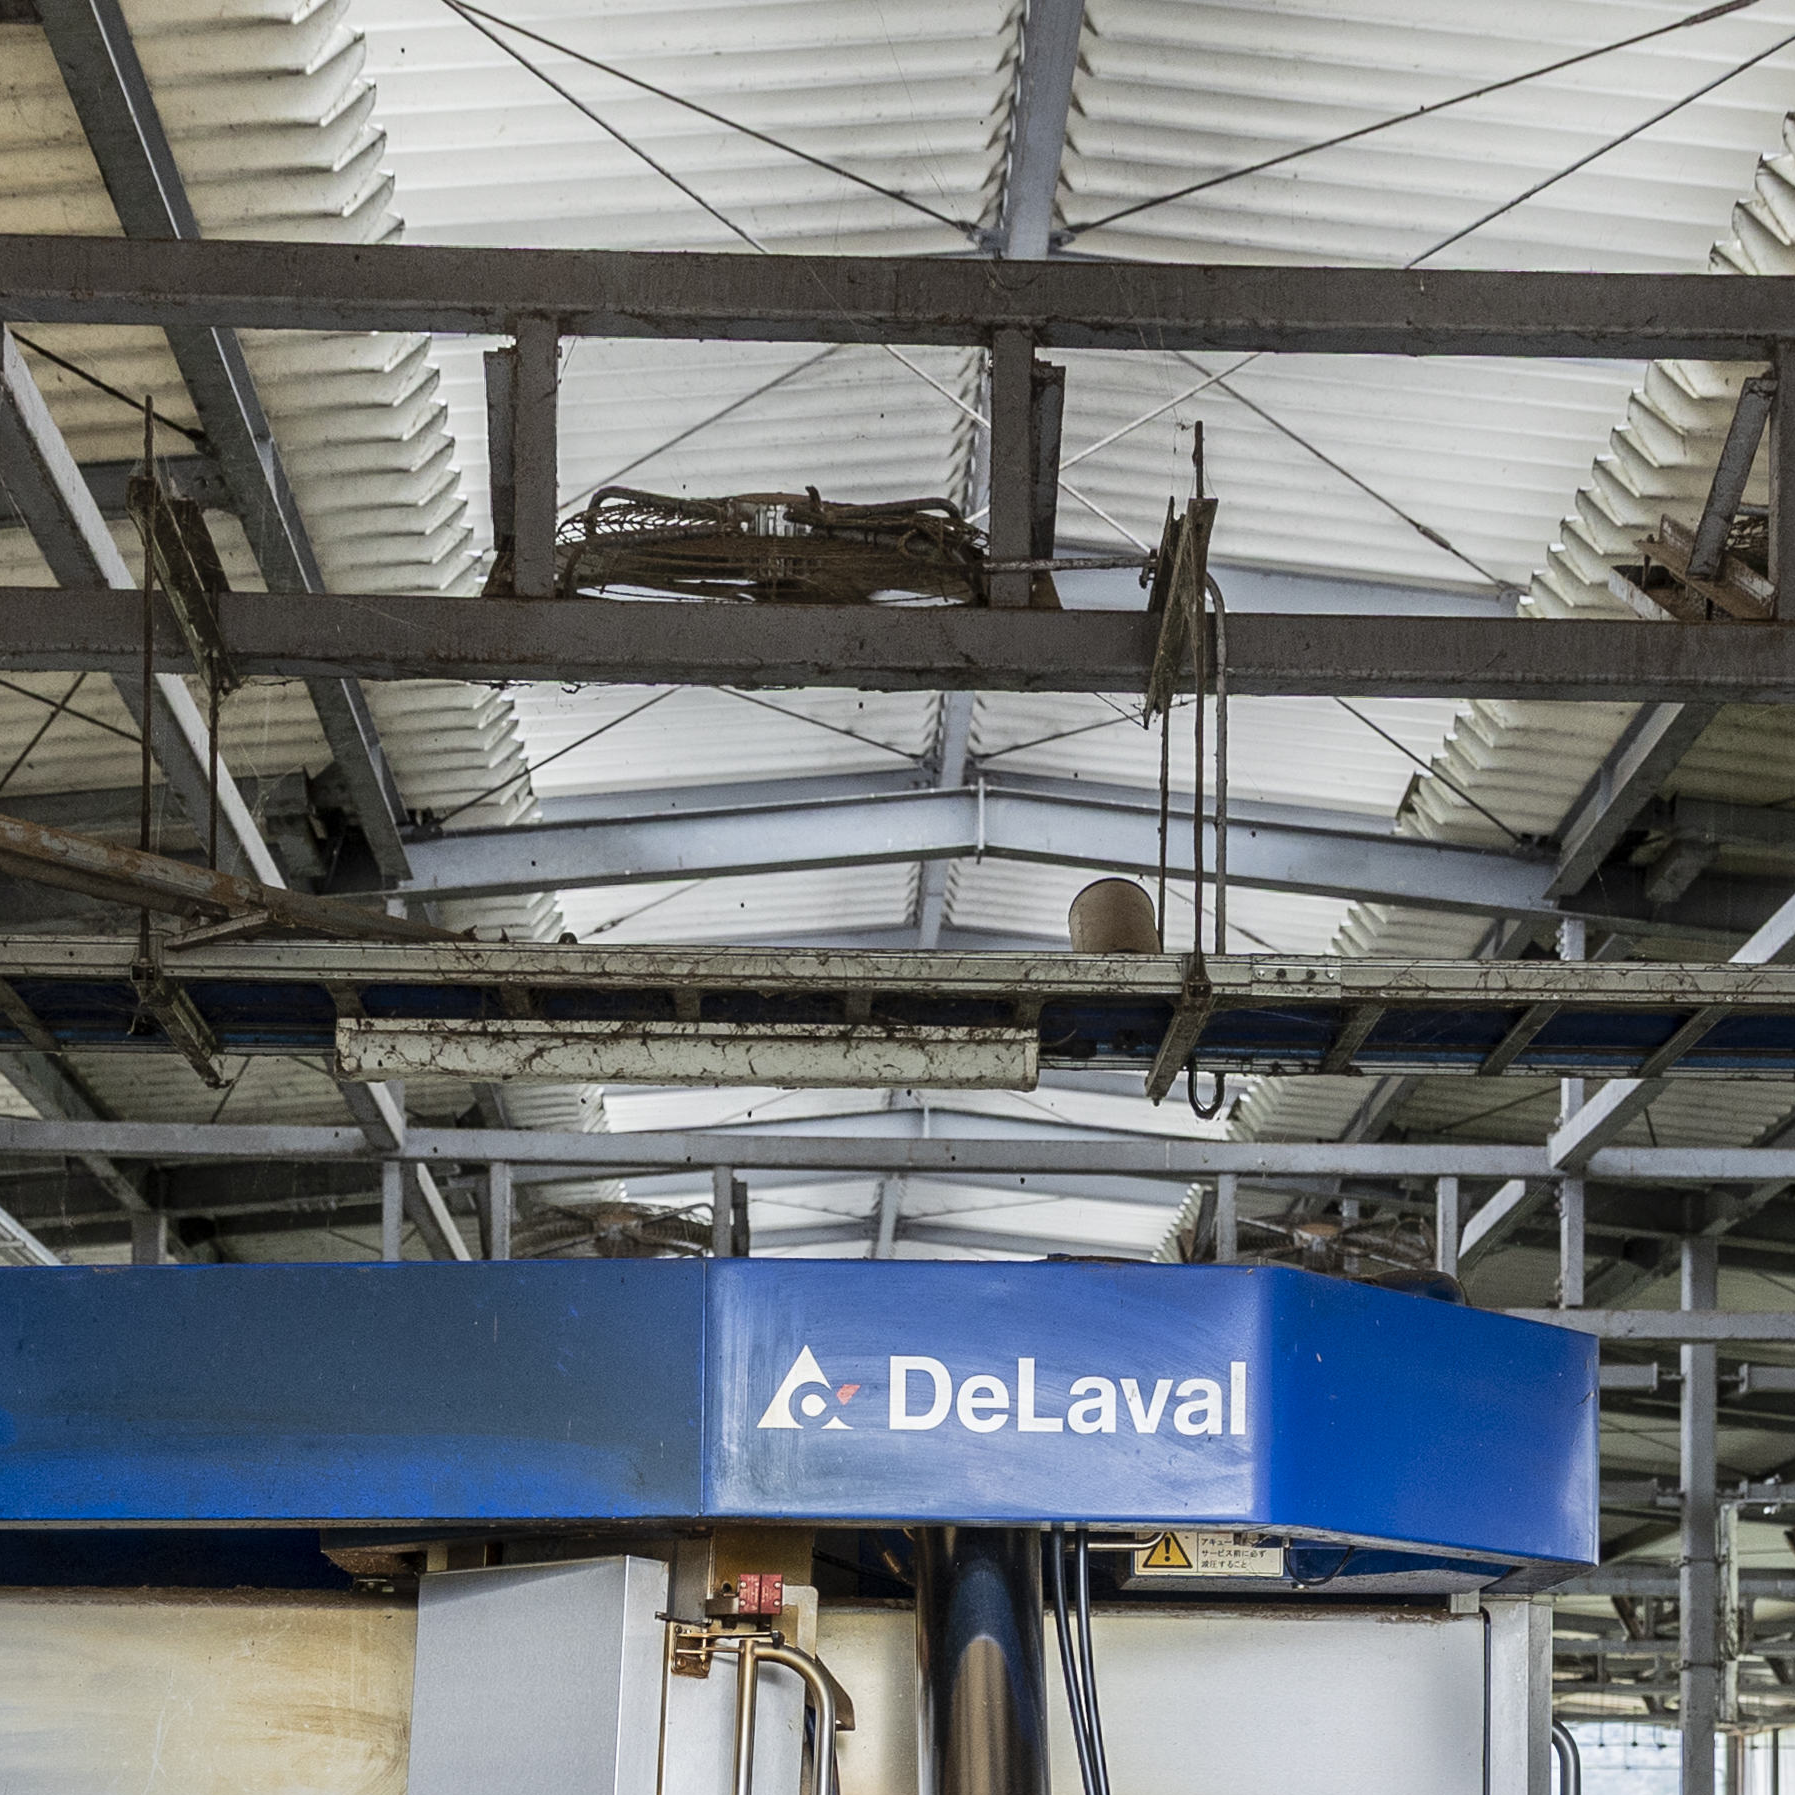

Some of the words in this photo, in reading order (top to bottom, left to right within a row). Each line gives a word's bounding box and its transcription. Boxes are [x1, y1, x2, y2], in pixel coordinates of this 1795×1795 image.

[889, 1355, 1246, 1436] DeLaval
[1201, 1550, 1267, 1558] サービス前に必ず
[1201, 1560, 1247, 1569] 減圧すること
